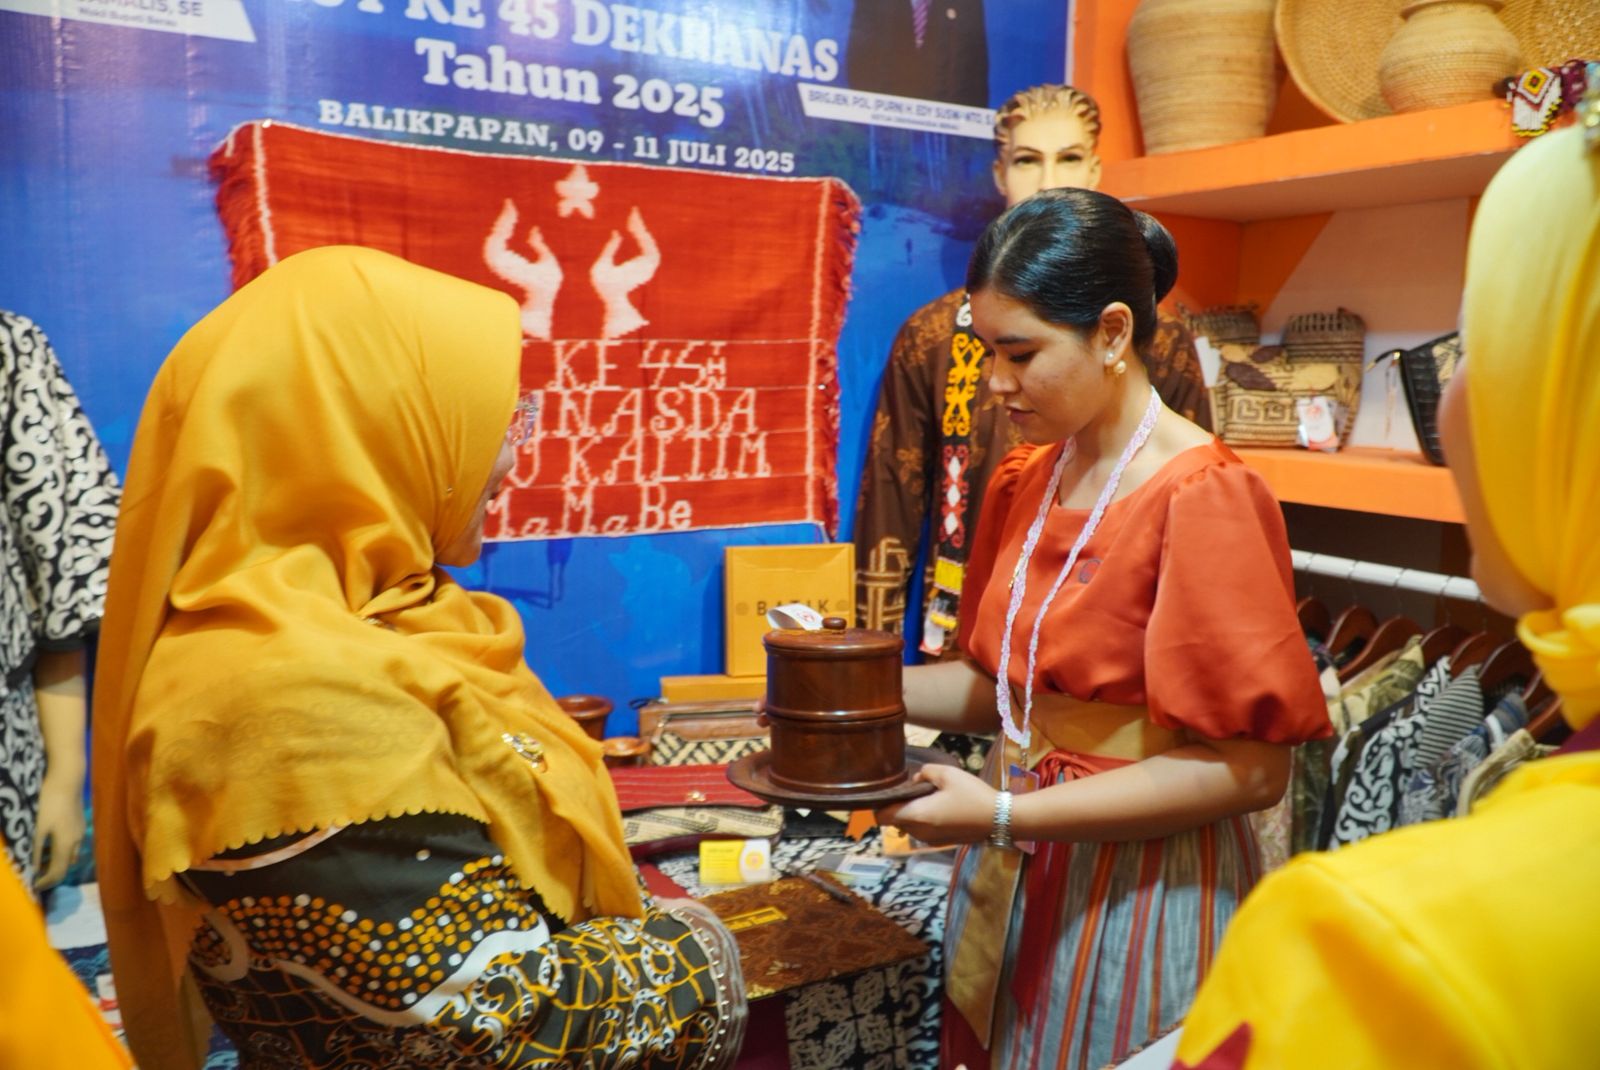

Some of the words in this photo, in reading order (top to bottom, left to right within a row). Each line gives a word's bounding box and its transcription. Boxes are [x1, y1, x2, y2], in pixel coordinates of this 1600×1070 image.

[178, 0, 203, 17] SE
[498, 0, 560, 39] 45
[571, 0, 839, 82] DEKRANAS
[415, 37, 602, 105] Tahun
[612, 74, 726, 128] 2025
[318, 99, 558, 152] BALIKPAPAN,
[567, 128, 605, 153] 09
[633, 135, 660, 159] 11
[666, 139, 727, 166] JULI
[734, 146, 795, 173] 2025
[546, 340, 622, 390] KE
